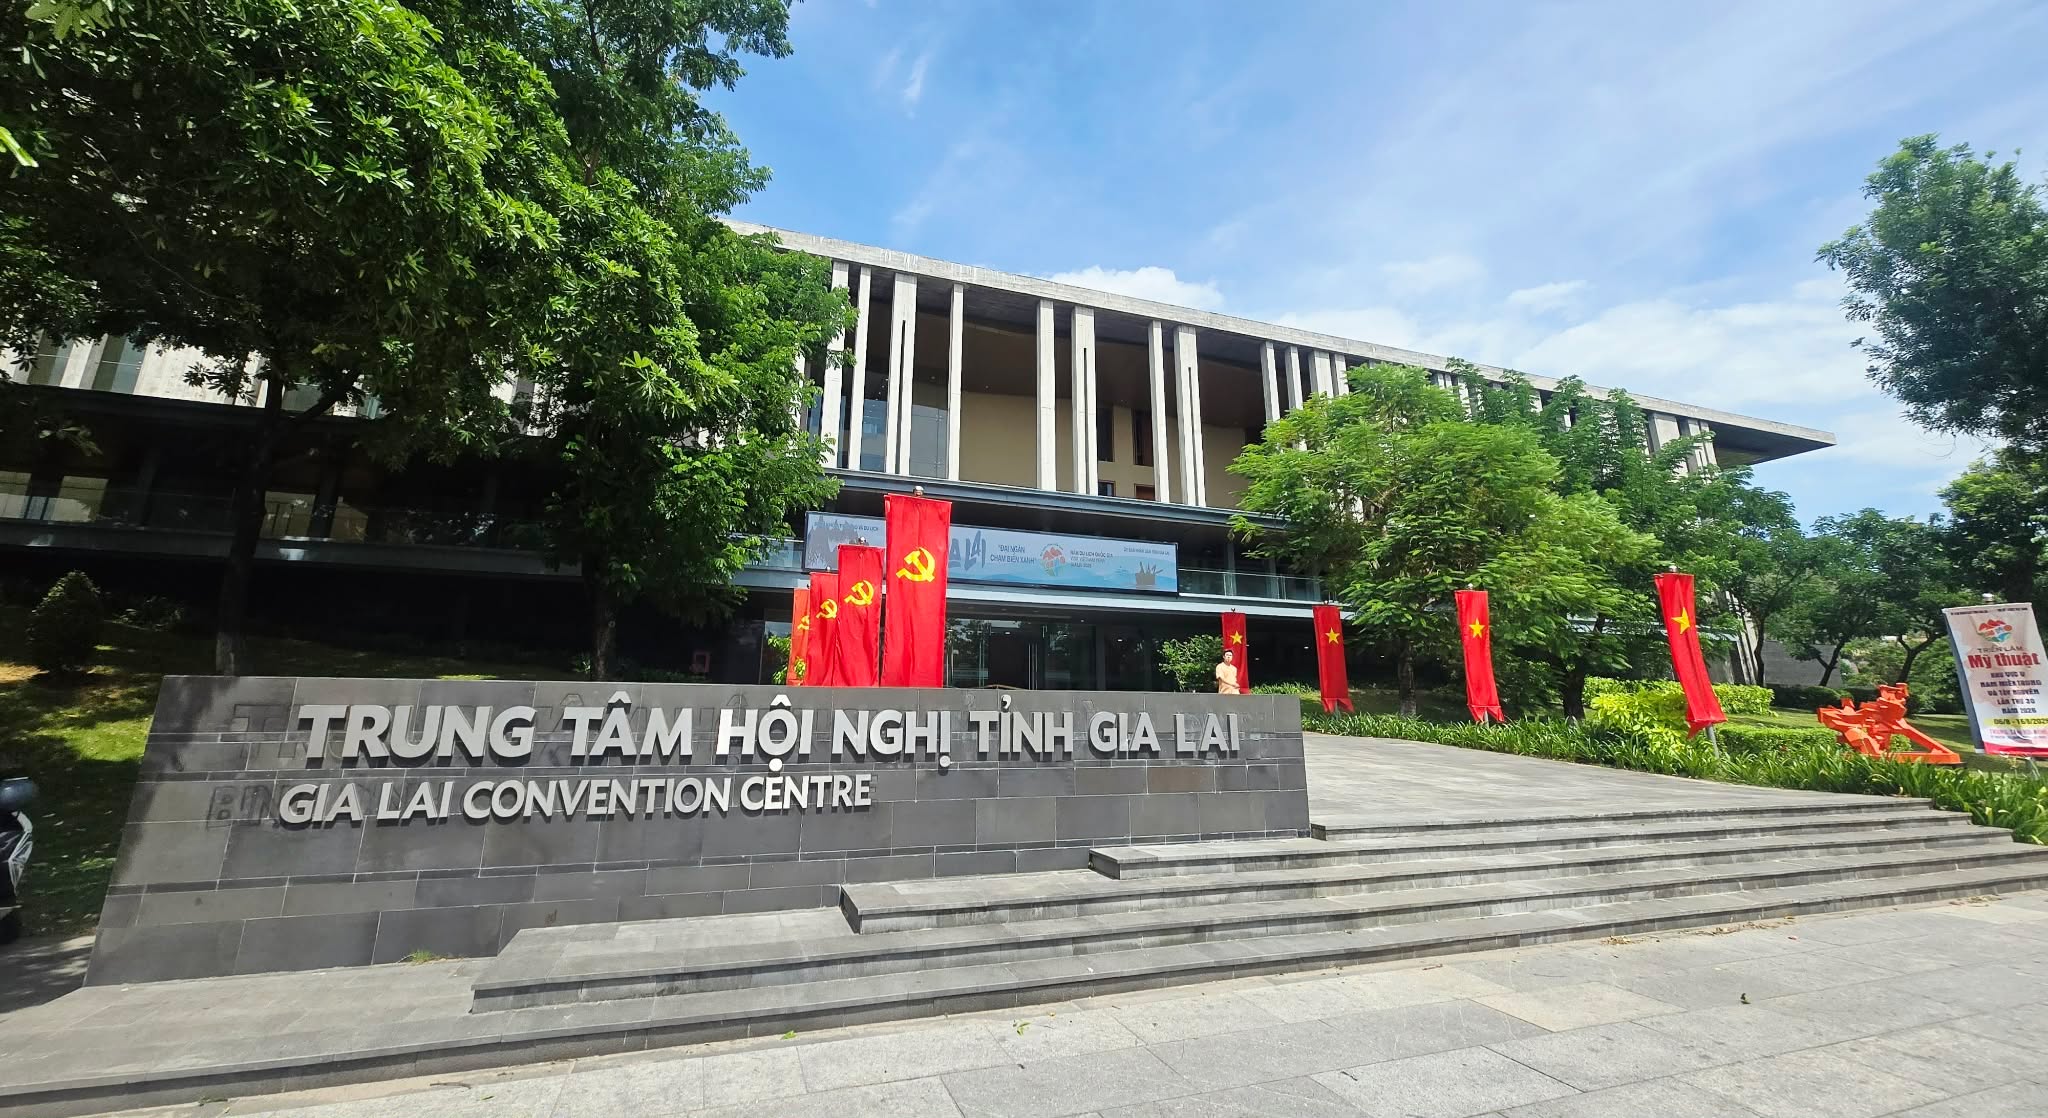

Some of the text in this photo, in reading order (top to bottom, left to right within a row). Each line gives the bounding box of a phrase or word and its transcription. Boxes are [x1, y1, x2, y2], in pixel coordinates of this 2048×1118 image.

[1968, 652, 2040, 669] Mỹ thuật
[298, 704, 537, 760] TRUNG
[562, 690, 693, 758] TÂM
[715, 694, 815, 772] HỘI
[831, 709, 951, 769] NGHỊ
[968, 694, 1074, 754] TỈNH
[1088, 710, 1161, 753] GIA
[1172, 712, 1241, 752] LAI
[278, 782, 364, 824] GIA
[376, 781, 454, 820] LAI
[462, 777, 733, 820] CONVENTION
[740, 774, 872, 812] CENTRE
